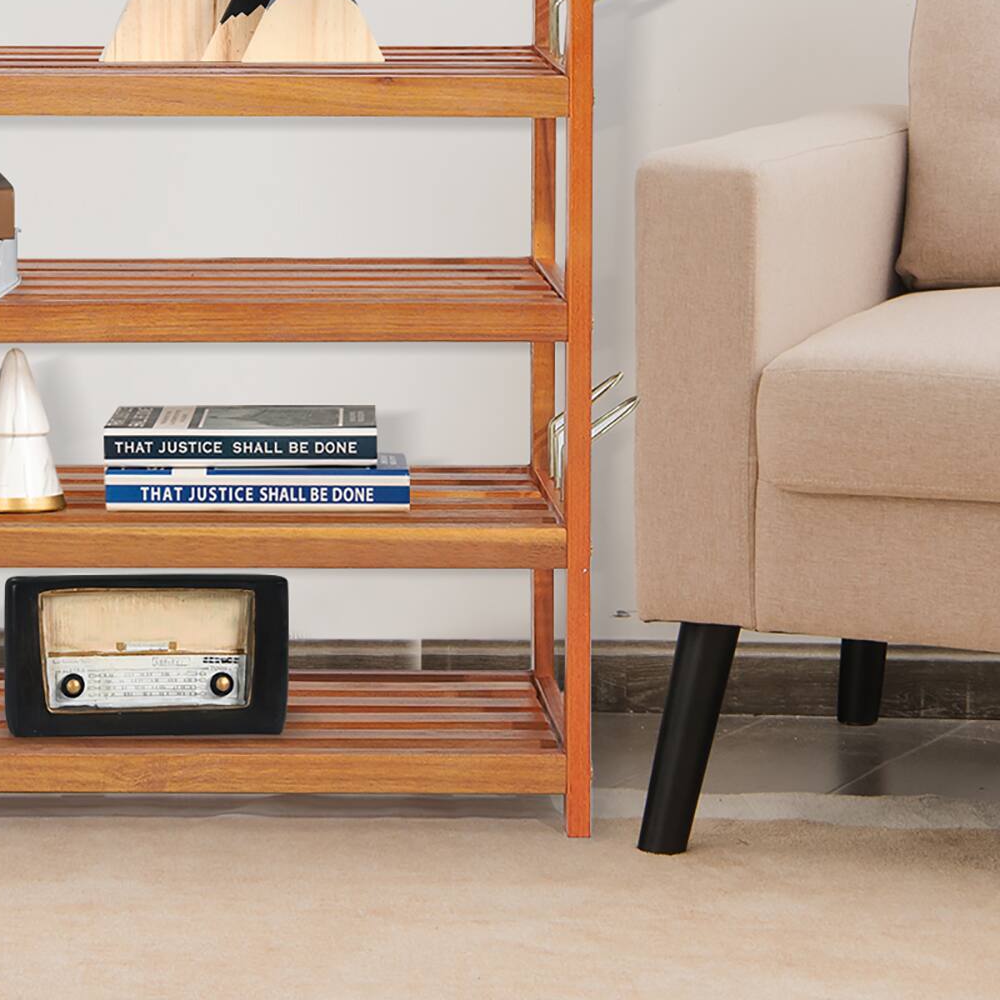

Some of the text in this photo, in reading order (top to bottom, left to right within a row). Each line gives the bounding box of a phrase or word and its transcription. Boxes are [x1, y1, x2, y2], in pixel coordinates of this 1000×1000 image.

[114, 441, 357, 454] THAT JUSTICE SHALL BE DONE
[140, 487, 374, 502] THAT JUSTICE SHALL BE DONE
